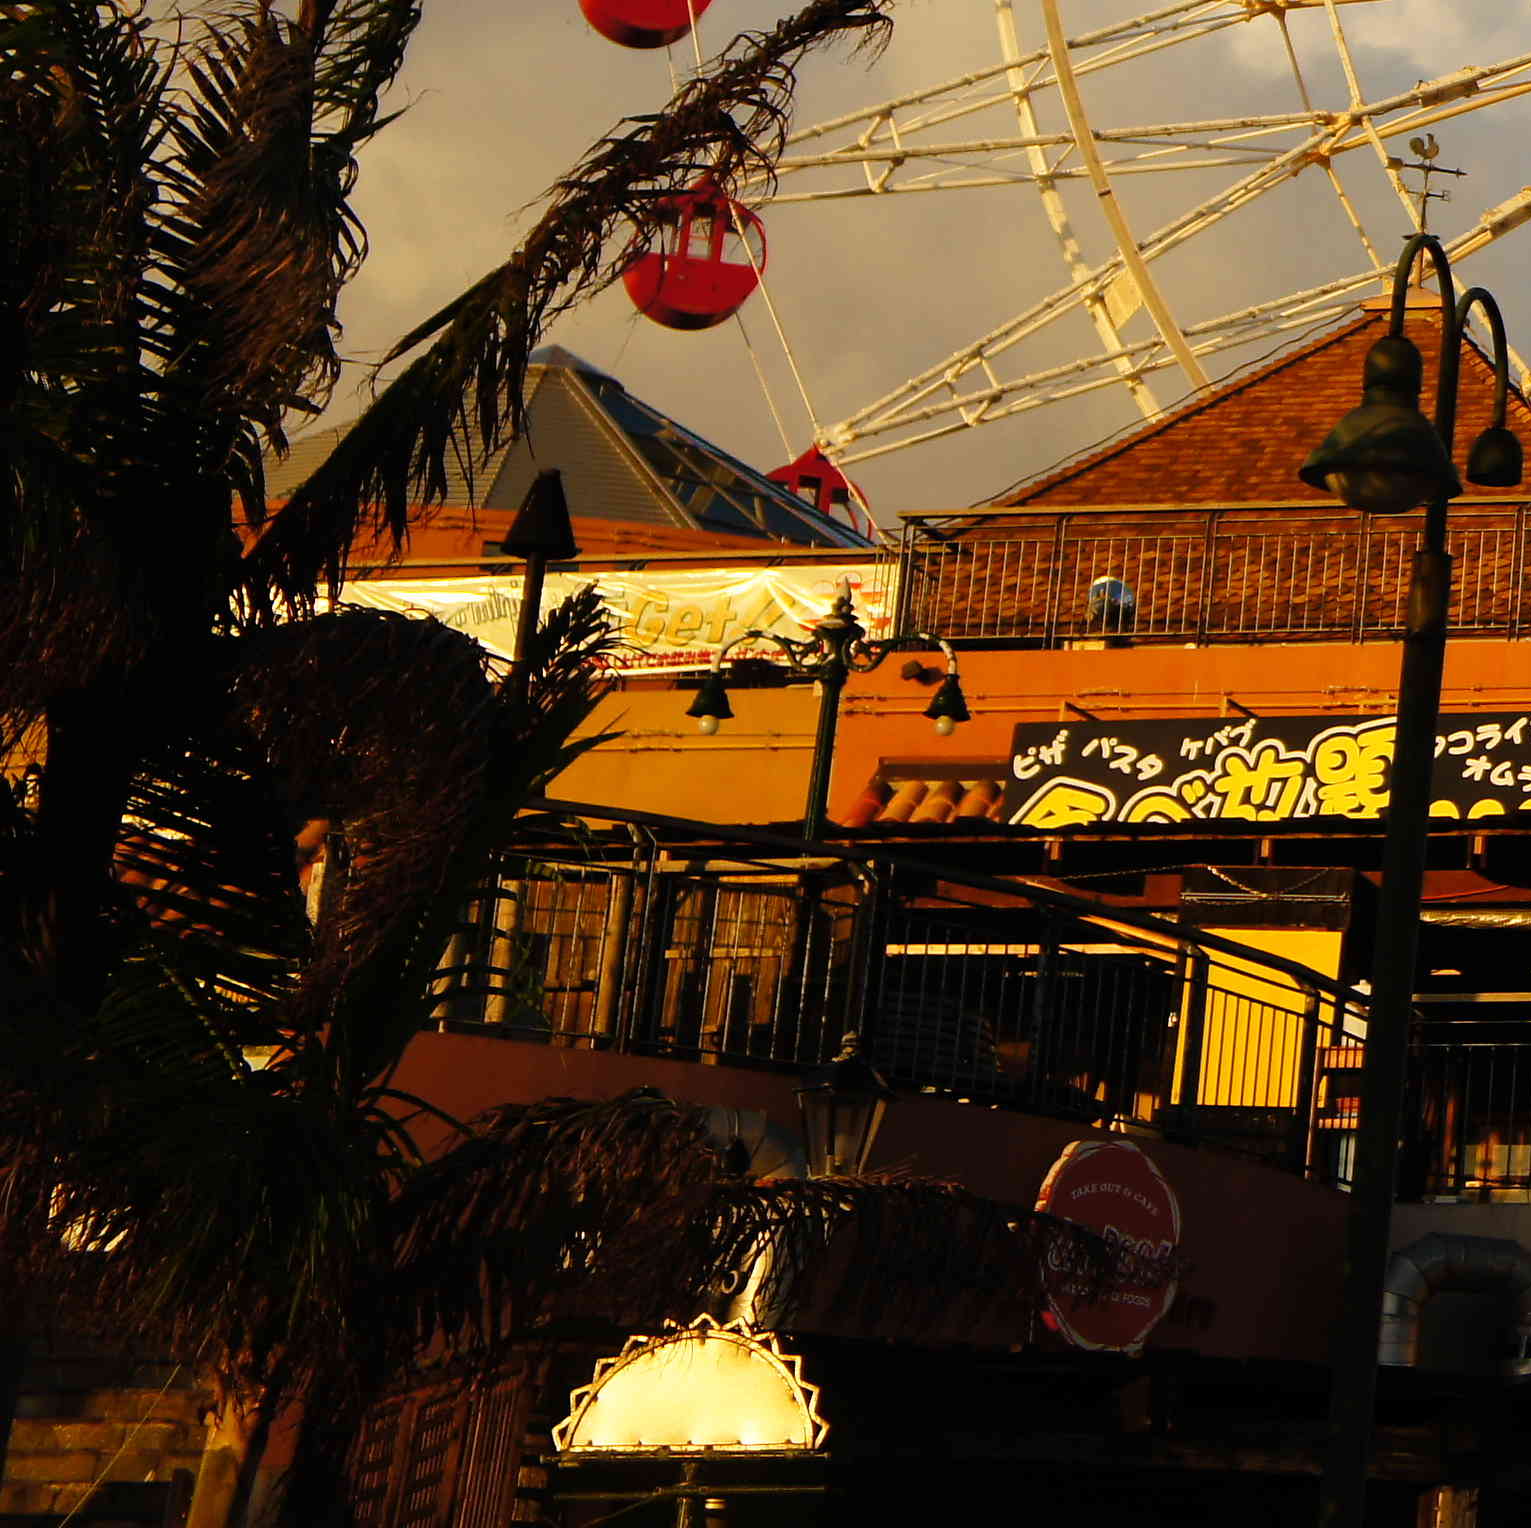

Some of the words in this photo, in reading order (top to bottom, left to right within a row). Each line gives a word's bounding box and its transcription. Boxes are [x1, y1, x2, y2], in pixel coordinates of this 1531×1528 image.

[1013, 730, 1069, 780] ピザ
[1081, 737, 1164, 780] パスタ
[1180, 718, 1258, 760] ケバブ
